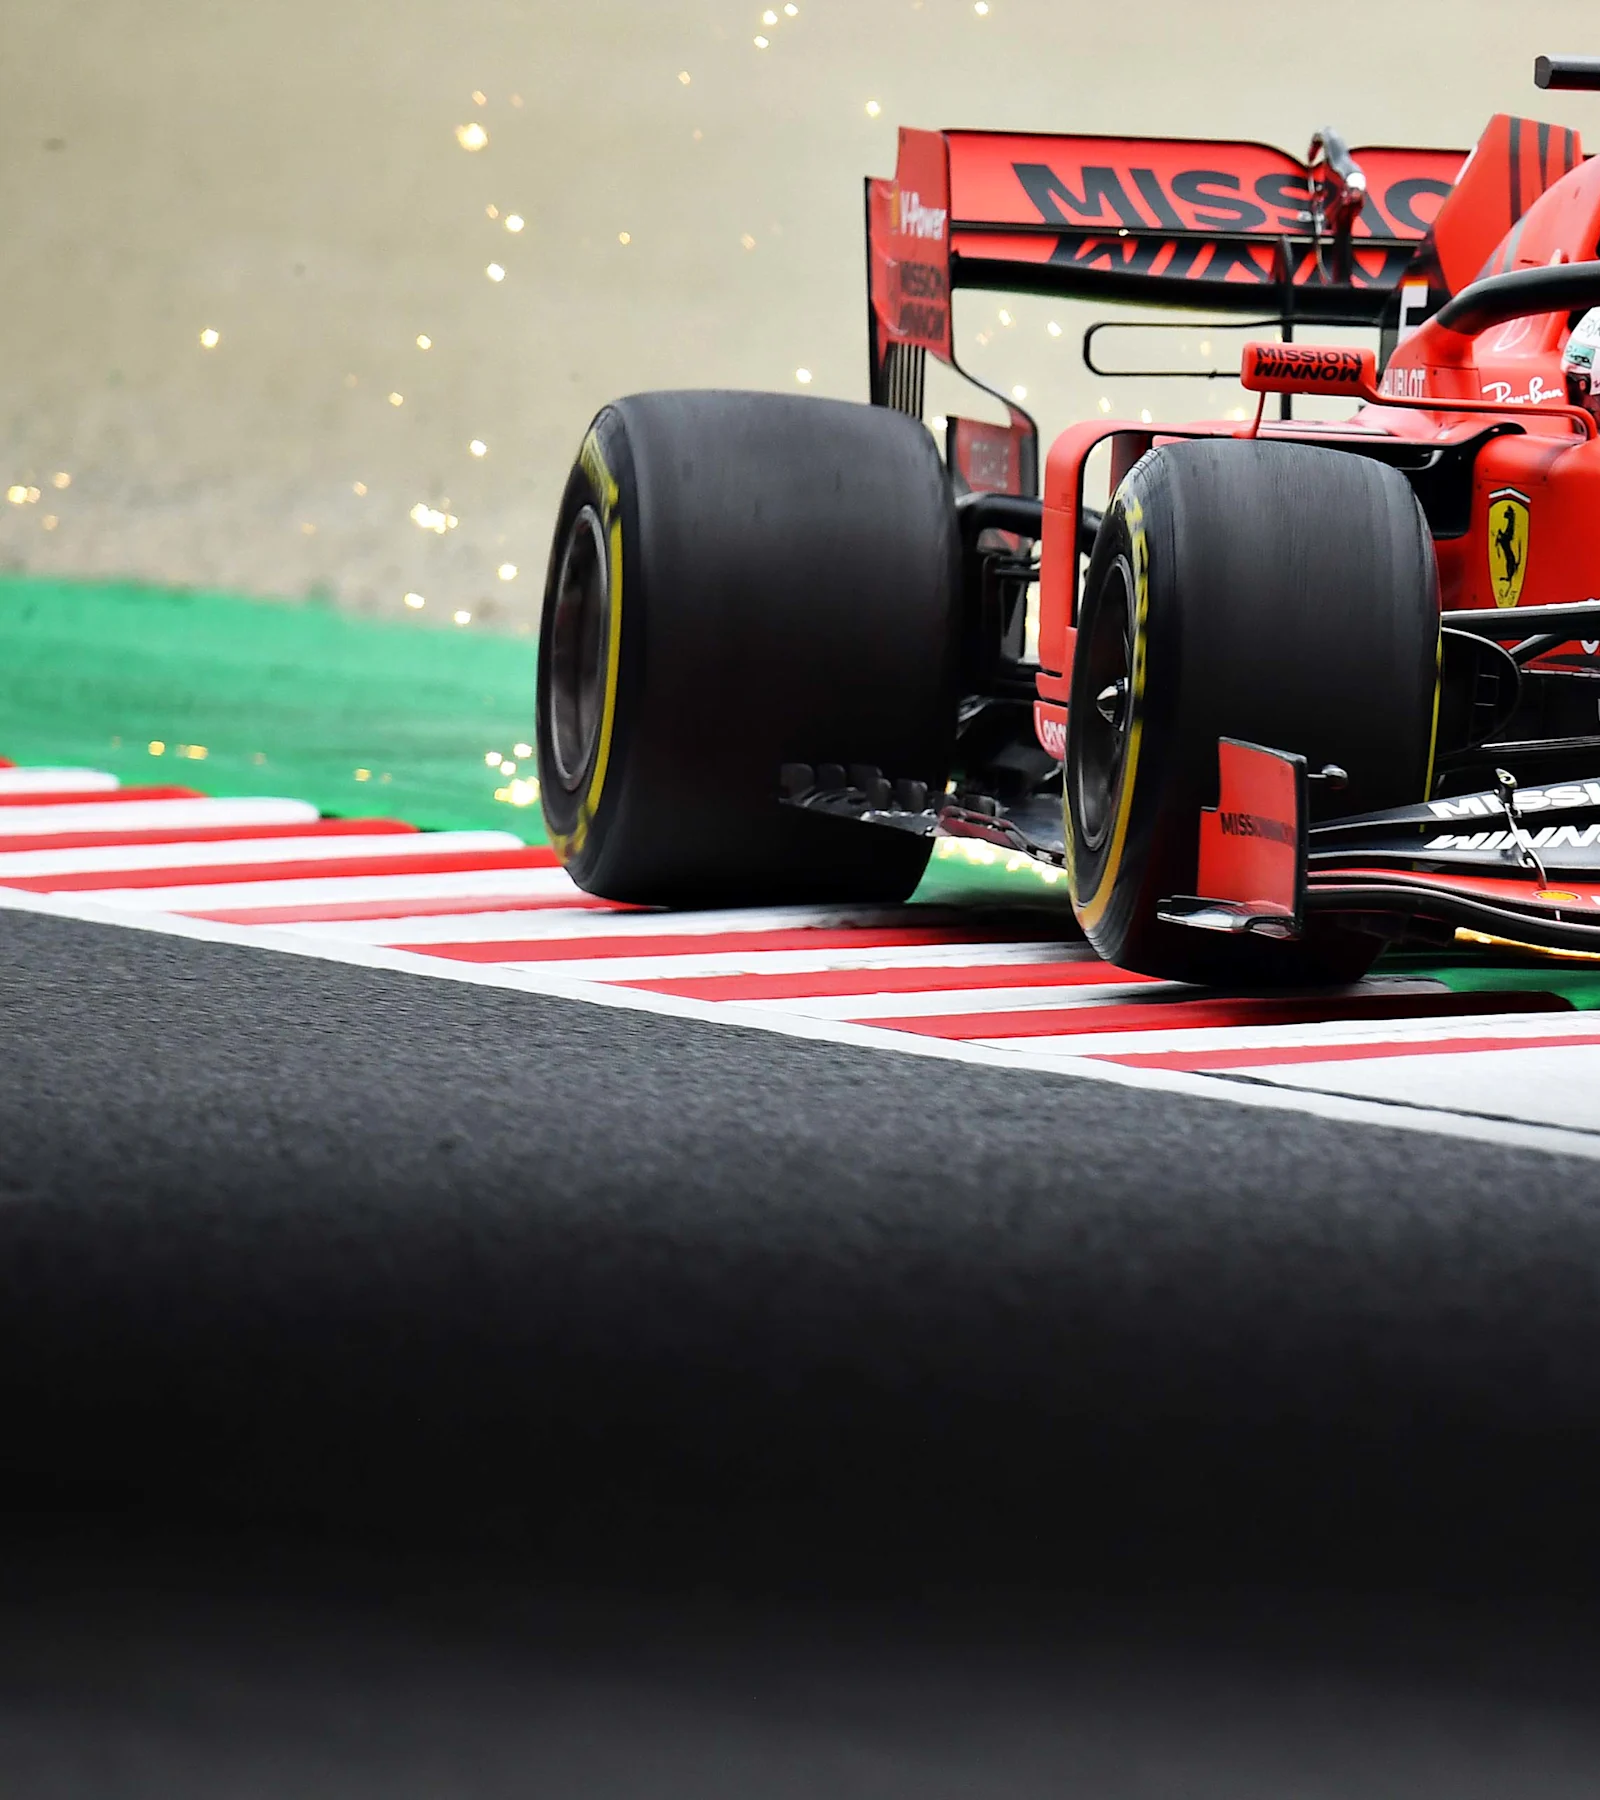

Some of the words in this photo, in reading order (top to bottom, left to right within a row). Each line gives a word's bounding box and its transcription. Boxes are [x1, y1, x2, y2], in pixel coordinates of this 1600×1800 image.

[1011, 162, 1447, 239] MISSIO
[1256, 347, 1363, 365] MISSION
[1253, 361, 1363, 382] WINNOW
